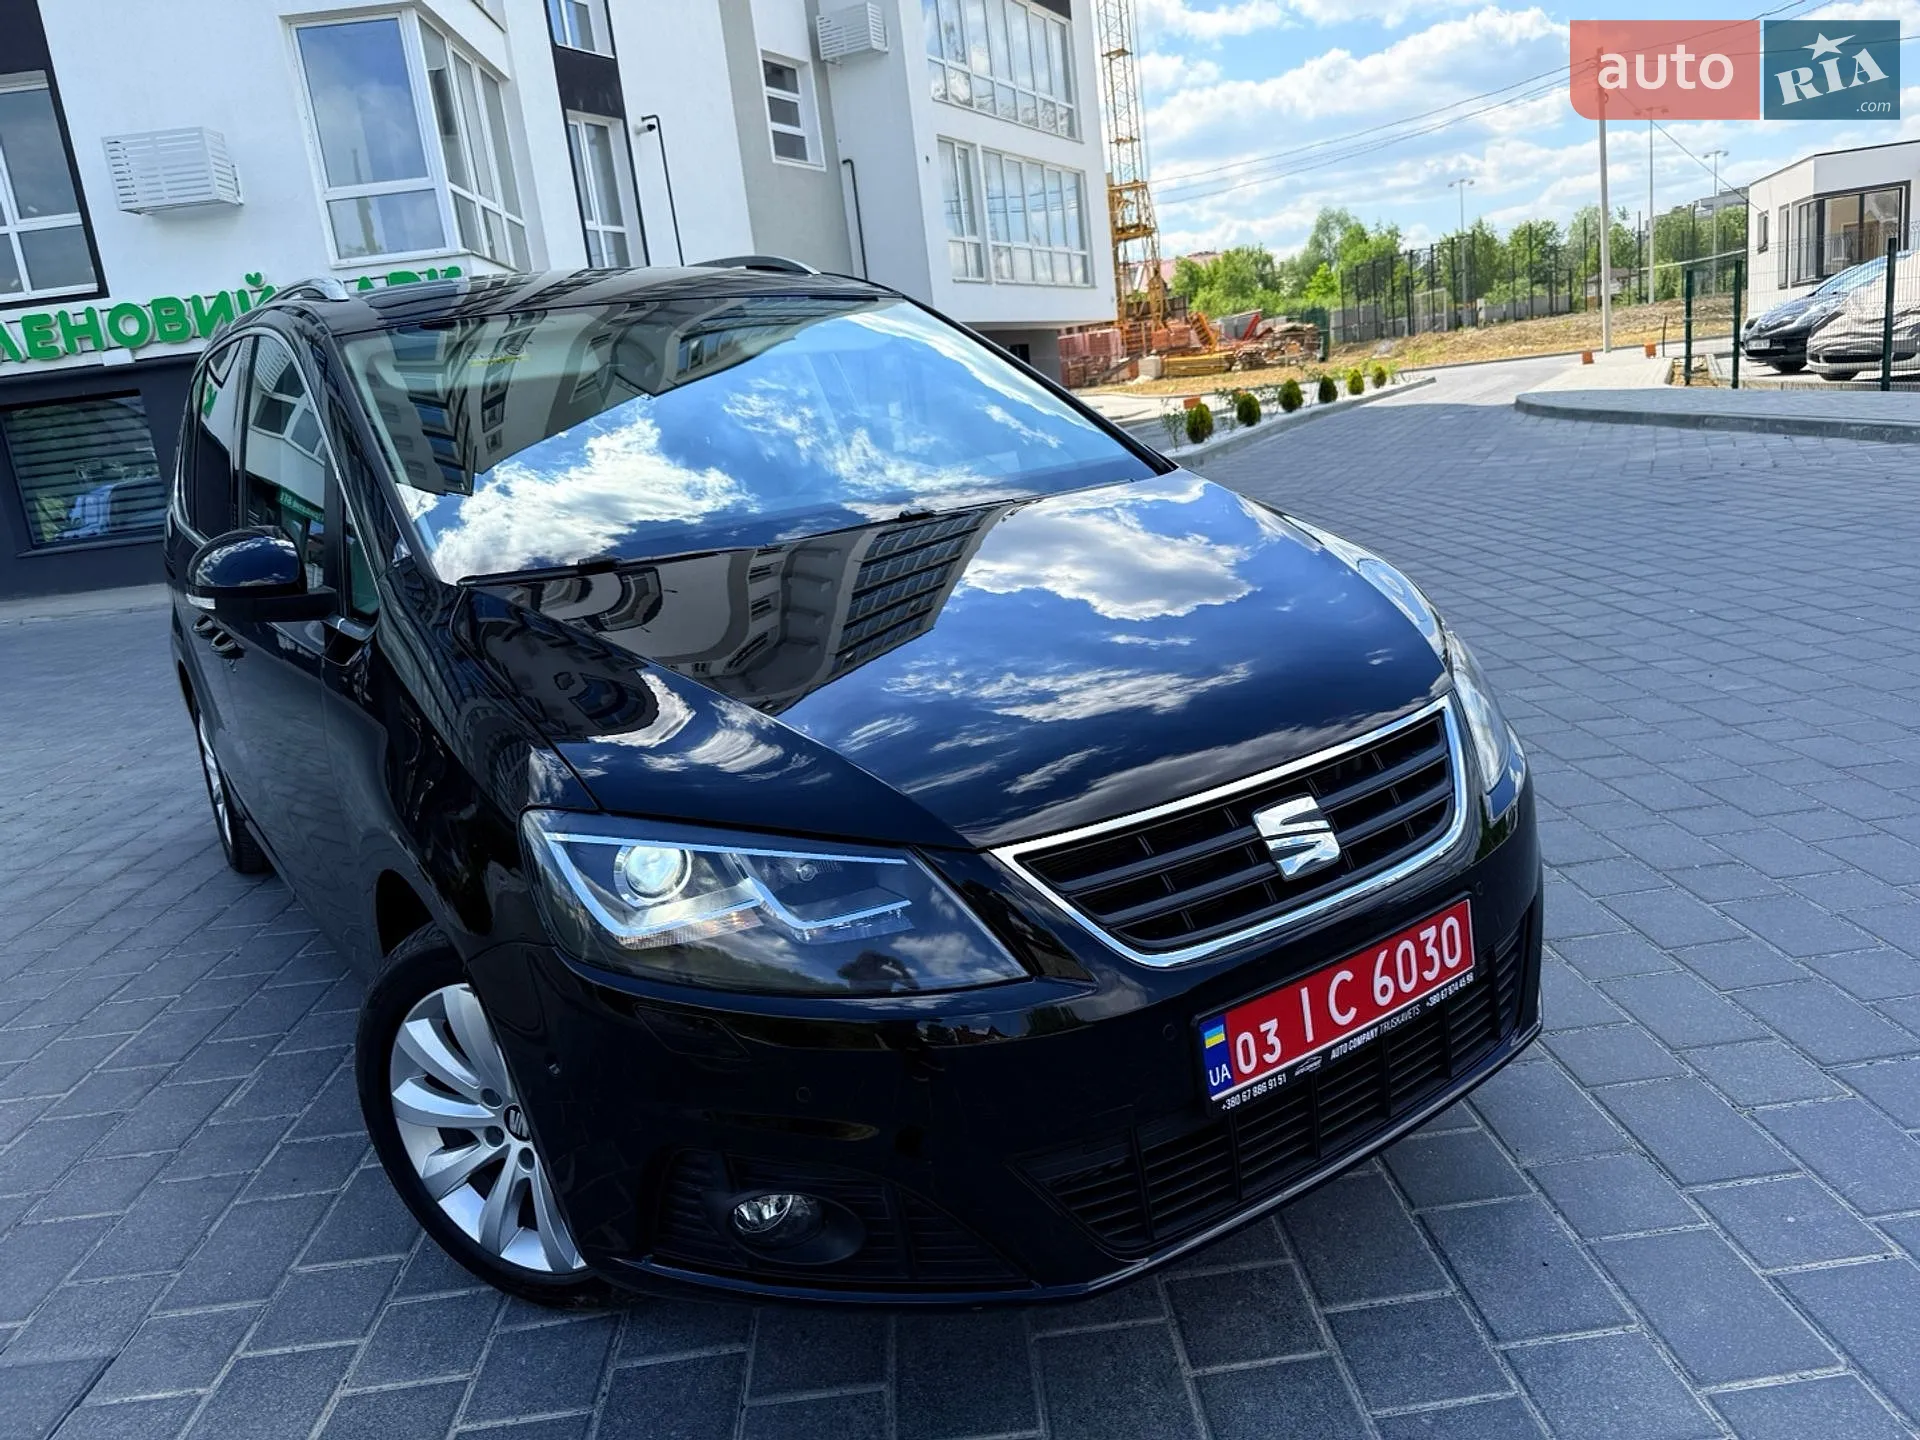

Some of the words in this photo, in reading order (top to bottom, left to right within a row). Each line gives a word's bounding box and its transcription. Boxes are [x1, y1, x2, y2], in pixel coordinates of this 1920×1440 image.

[1235, 1017, 1282, 1075] 03
[1373, 916, 1462, 1006] 6030
[1330, 1042, 1348, 1060] AUTO
[1348, 1026, 1379, 1051] COMPANY
[1209, 1064, 1232, 1087] UA
